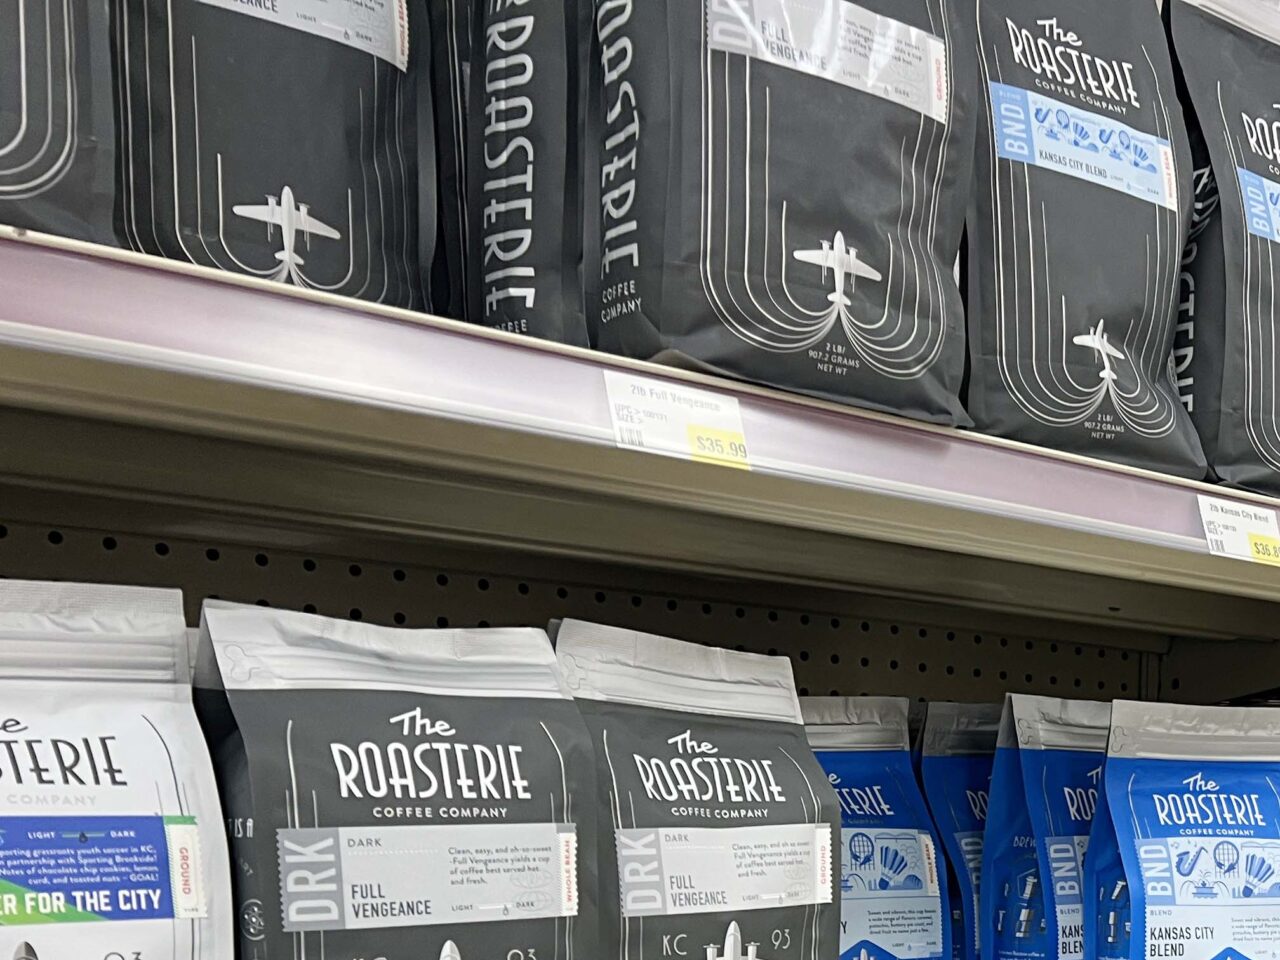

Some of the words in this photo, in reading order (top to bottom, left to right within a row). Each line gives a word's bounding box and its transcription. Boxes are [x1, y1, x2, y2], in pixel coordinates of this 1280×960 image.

[1037, 18, 1083, 47] The
[1005, 17, 1140, 109] ROASTERIE
[1034, 77, 1077, 102] COFFEE
[1079, 93, 1128, 115] COMPANY
[817, 362, 833, 374] NET
[835, 366, 848, 376] WT
[696, 435, 748, 459] $35.99
[390, 707, 456, 737] The
[668, 729, 718, 754] The
[330, 741, 532, 801] ROASTERIE
[633, 753, 786, 802] ROASTERIE
[1183, 772, 1220, 792] The
[373, 807, 433, 818] COFFEE
[439, 807, 508, 818] COMPANY
[671, 807, 711, 818] COFFEE
[714, 808, 769, 818] COMPANY
[1153, 794, 1266, 827] ROASTERIE
[347, 838, 382, 848] DARK
[1216, 829, 1254, 837] COMPANY
[284, 837, 340, 922] DRK
[620, 832, 663, 910] DRK
[669, 875, 695, 889] FULL
[25, 891, 66, 915] FOR
[72, 890, 112, 911] THE
[119, 889, 162, 910] CITY
[351, 884, 385, 900] FULL
[670, 891, 728, 908] VENGEANCE
[352, 900, 432, 919] VENGEANCE
[1150, 926, 1192, 942] KANSAS
[1194, 926, 1215, 940] CITY
[1150, 943, 1185, 958] BLEND
